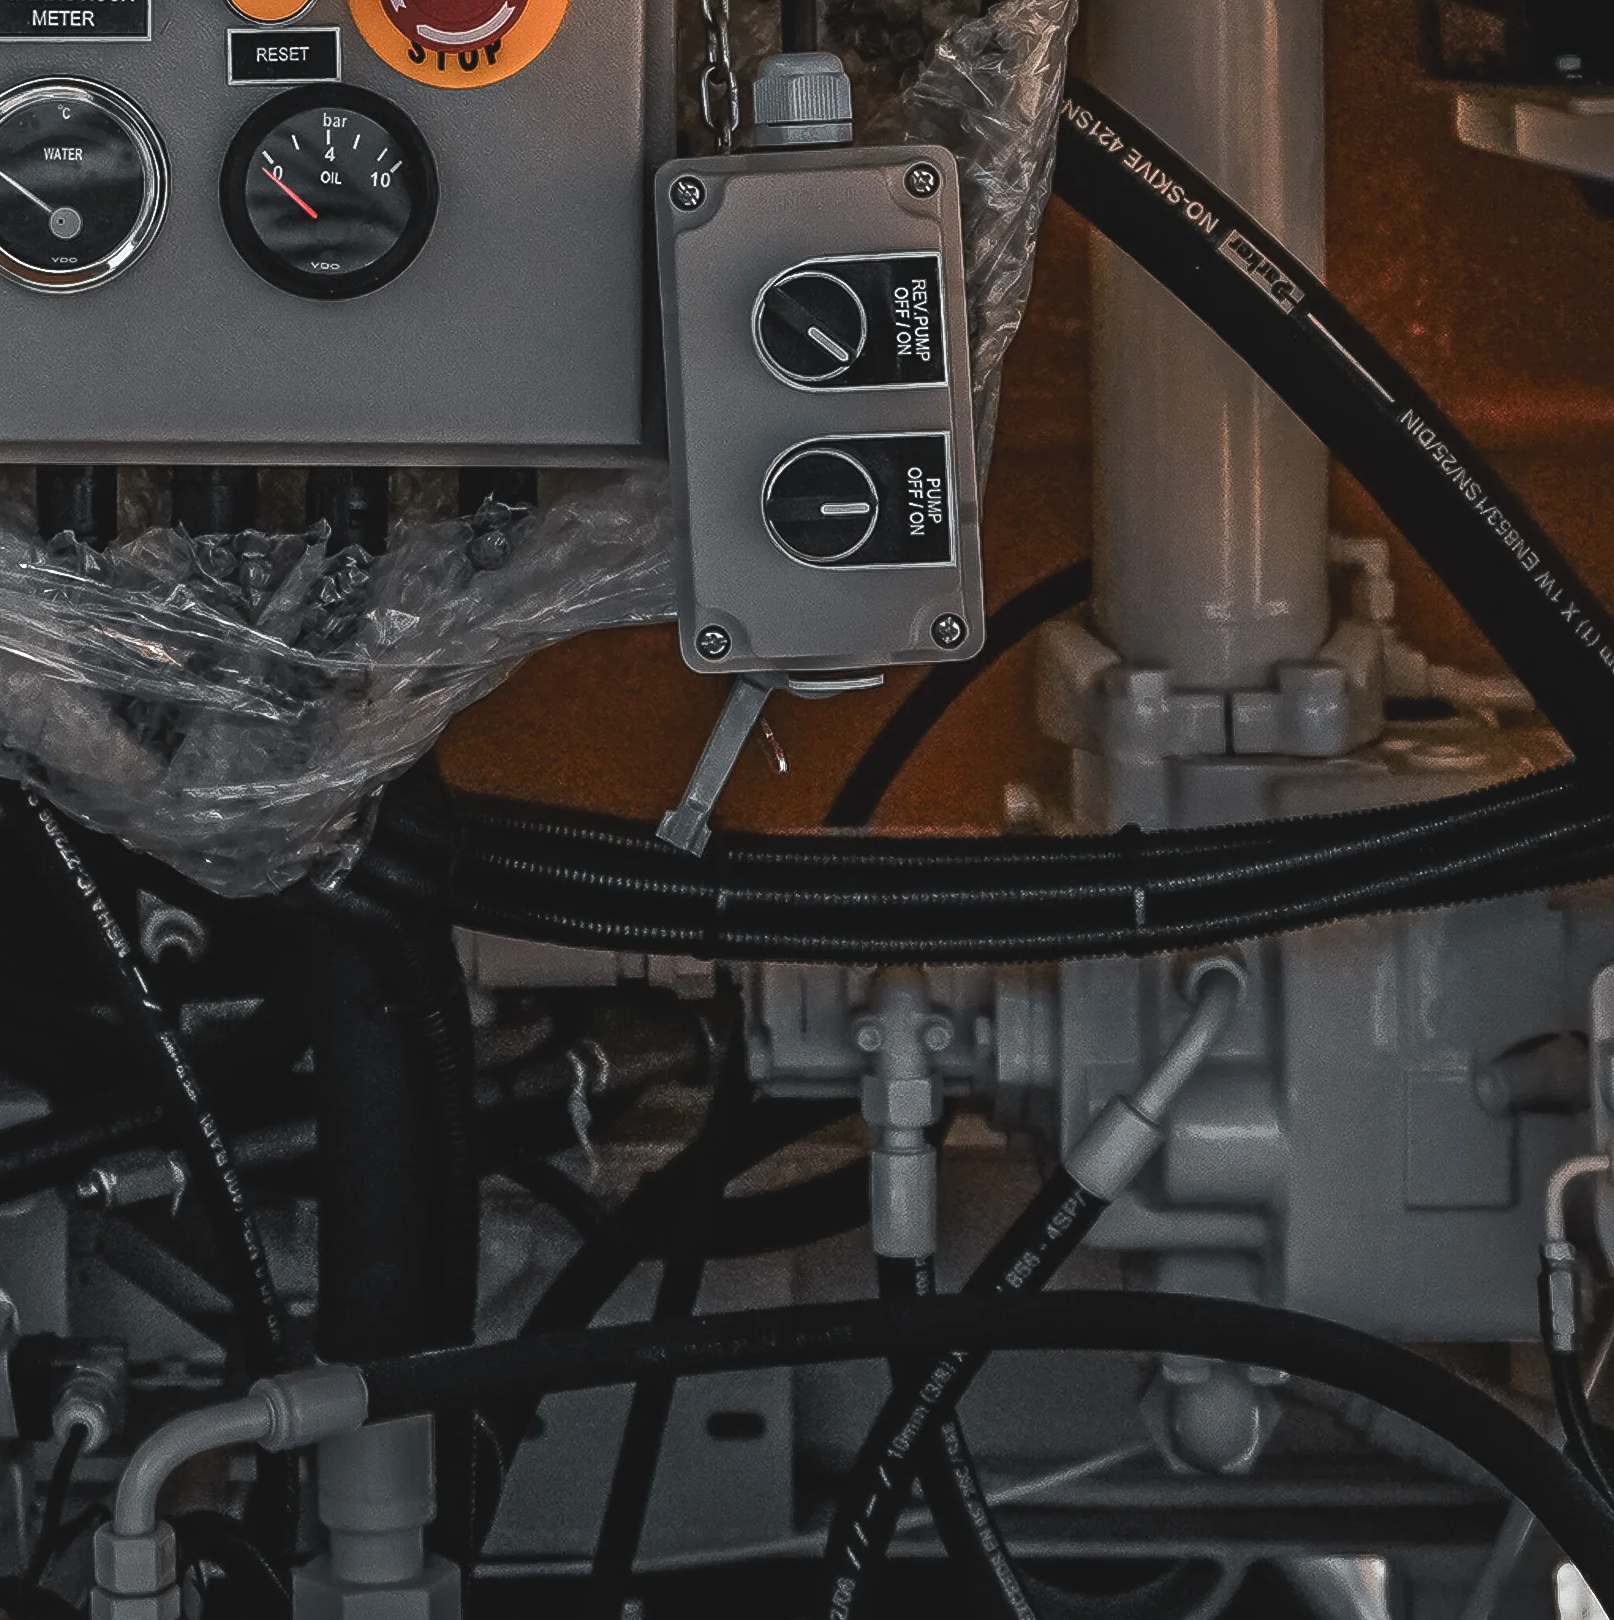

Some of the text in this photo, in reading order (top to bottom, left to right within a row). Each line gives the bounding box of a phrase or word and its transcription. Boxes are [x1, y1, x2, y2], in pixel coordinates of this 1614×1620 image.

[32, 9, 95, 27] METER
[256, 46, 309, 62] RESET
[323, 113, 347, 128] bar
[43, 147, 83, 161] WATER
[324, 147, 335, 162] 4
[272, 165, 283, 180] 0
[320, 171, 342, 185] OIL
[370, 172, 391, 188] 10
[1123, 144, 1220, 234] NO-SKIVE
[894, 287, 910, 318] OFF
[897, 331, 912, 356] ON
[907, 467, 923, 499] OFF
[926, 478, 941, 524] PUMP
[910, 511, 925, 536] ON
[1560, 601, 1580, 622] X
